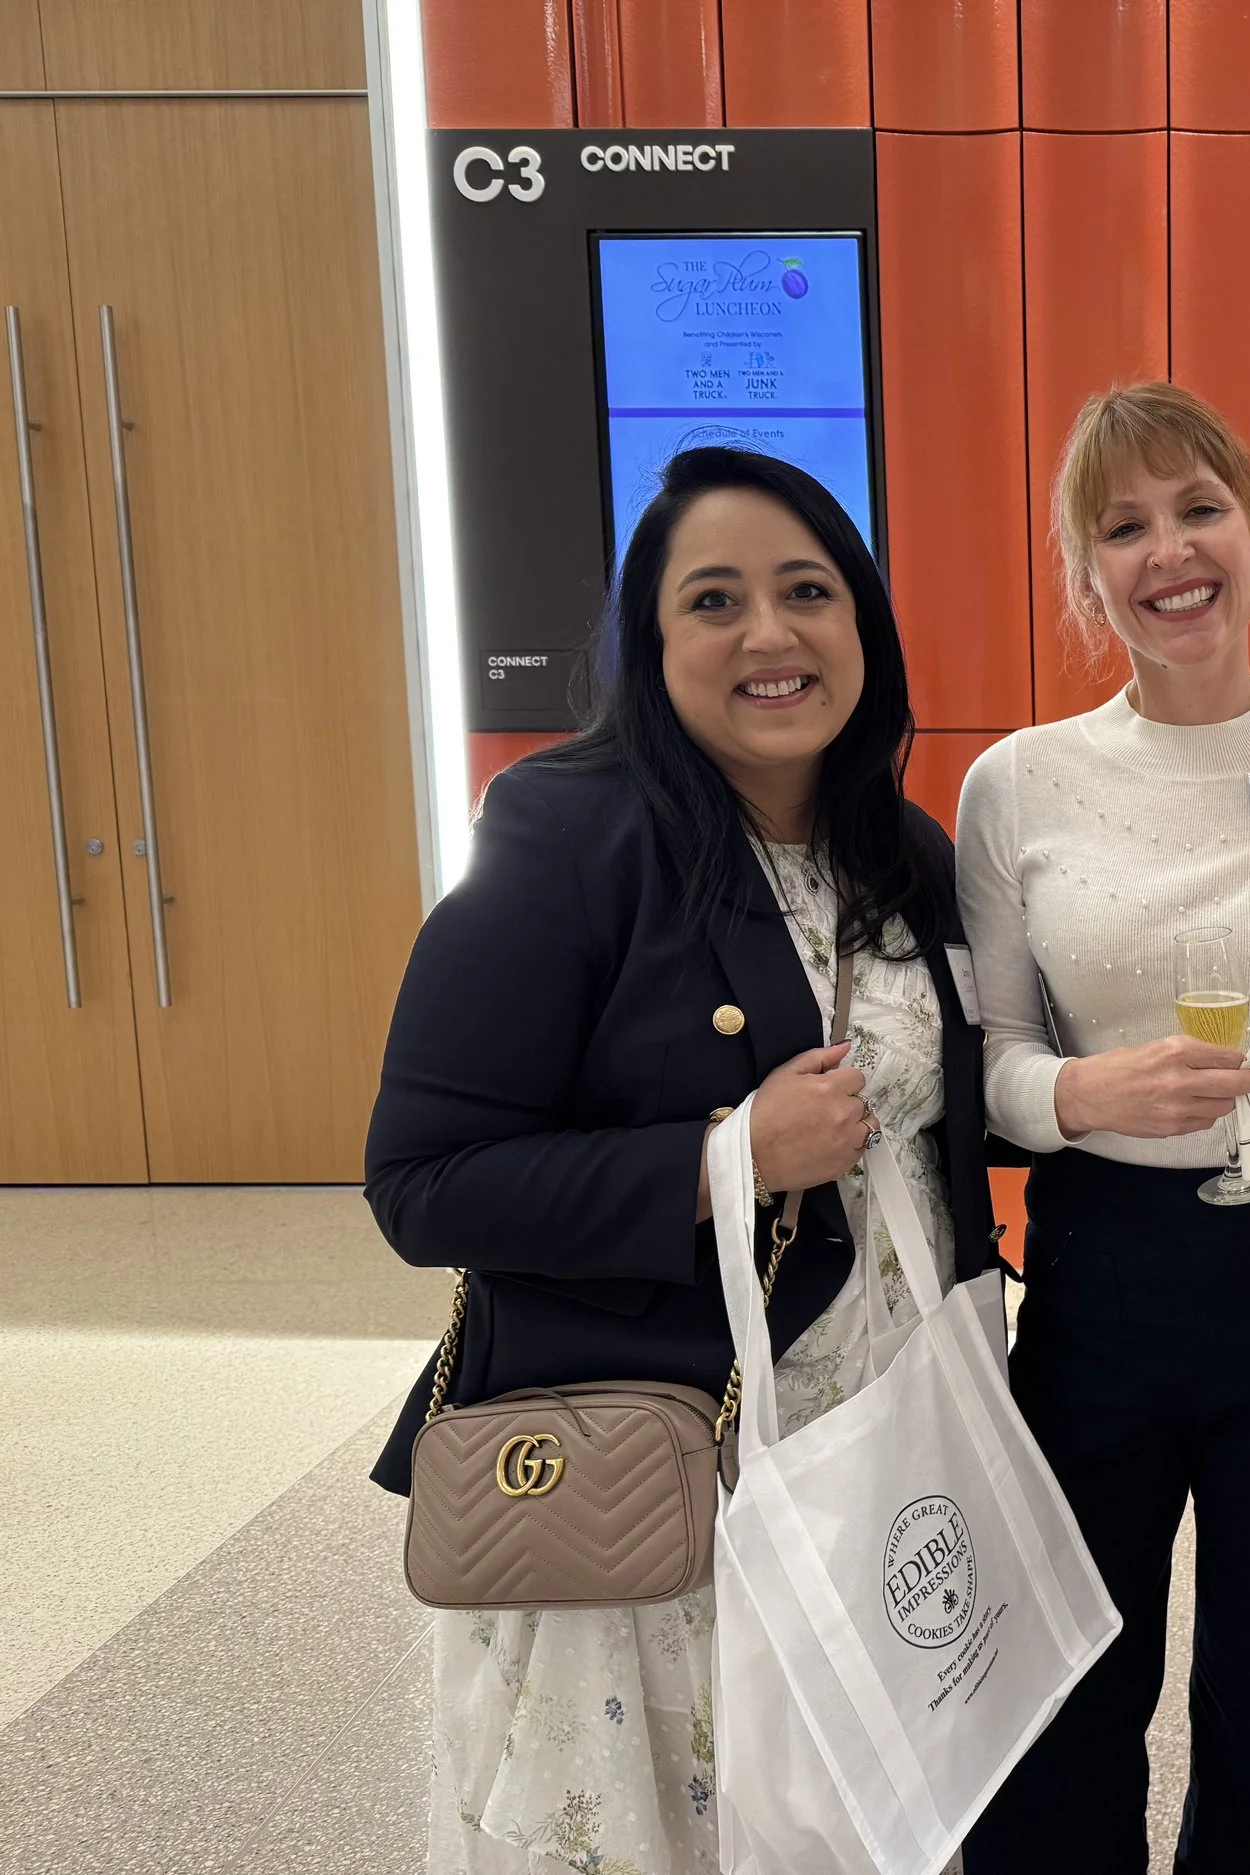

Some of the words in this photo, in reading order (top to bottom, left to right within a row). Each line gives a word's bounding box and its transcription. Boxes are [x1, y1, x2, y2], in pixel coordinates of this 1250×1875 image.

[580, 145, 735, 172] CONNECT
[453, 146, 546, 202] C3
[683, 261, 708, 272] THE
[650, 262, 717, 322] Sugar
[713, 250, 780, 293] Plum
[696, 302, 782, 316] LUNCHEON
[753, 341, 762, 349] by
[685, 370, 707, 378] TWO
[709, 370, 730, 378] MEN
[745, 379, 777, 389] JUNK
[693, 380, 714, 389] AND
[716, 380, 724, 389] A
[752, 429, 784, 438] Events
[488, 656, 548, 667] CONNECT
[489, 669, 505, 679] C3
[888, 1517, 911, 1568] WHERE
[911, 1503, 949, 1521] GREAT
[886, 1512, 964, 1609] EDIBLE
[897, 1539, 968, 1623] IMPRESSIONS
[907, 1623, 954, 1640] COOKIES
[953, 1599, 971, 1628] TAKE
[966, 1555, 974, 1599] SHAPE
[937, 1660, 957, 1682] Every
[957, 1638, 973, 1662] cookie
[928, 1684, 953, 1712] Thanks
[952, 1672, 963, 1687] for
[962, 1648, 979, 1676] making
